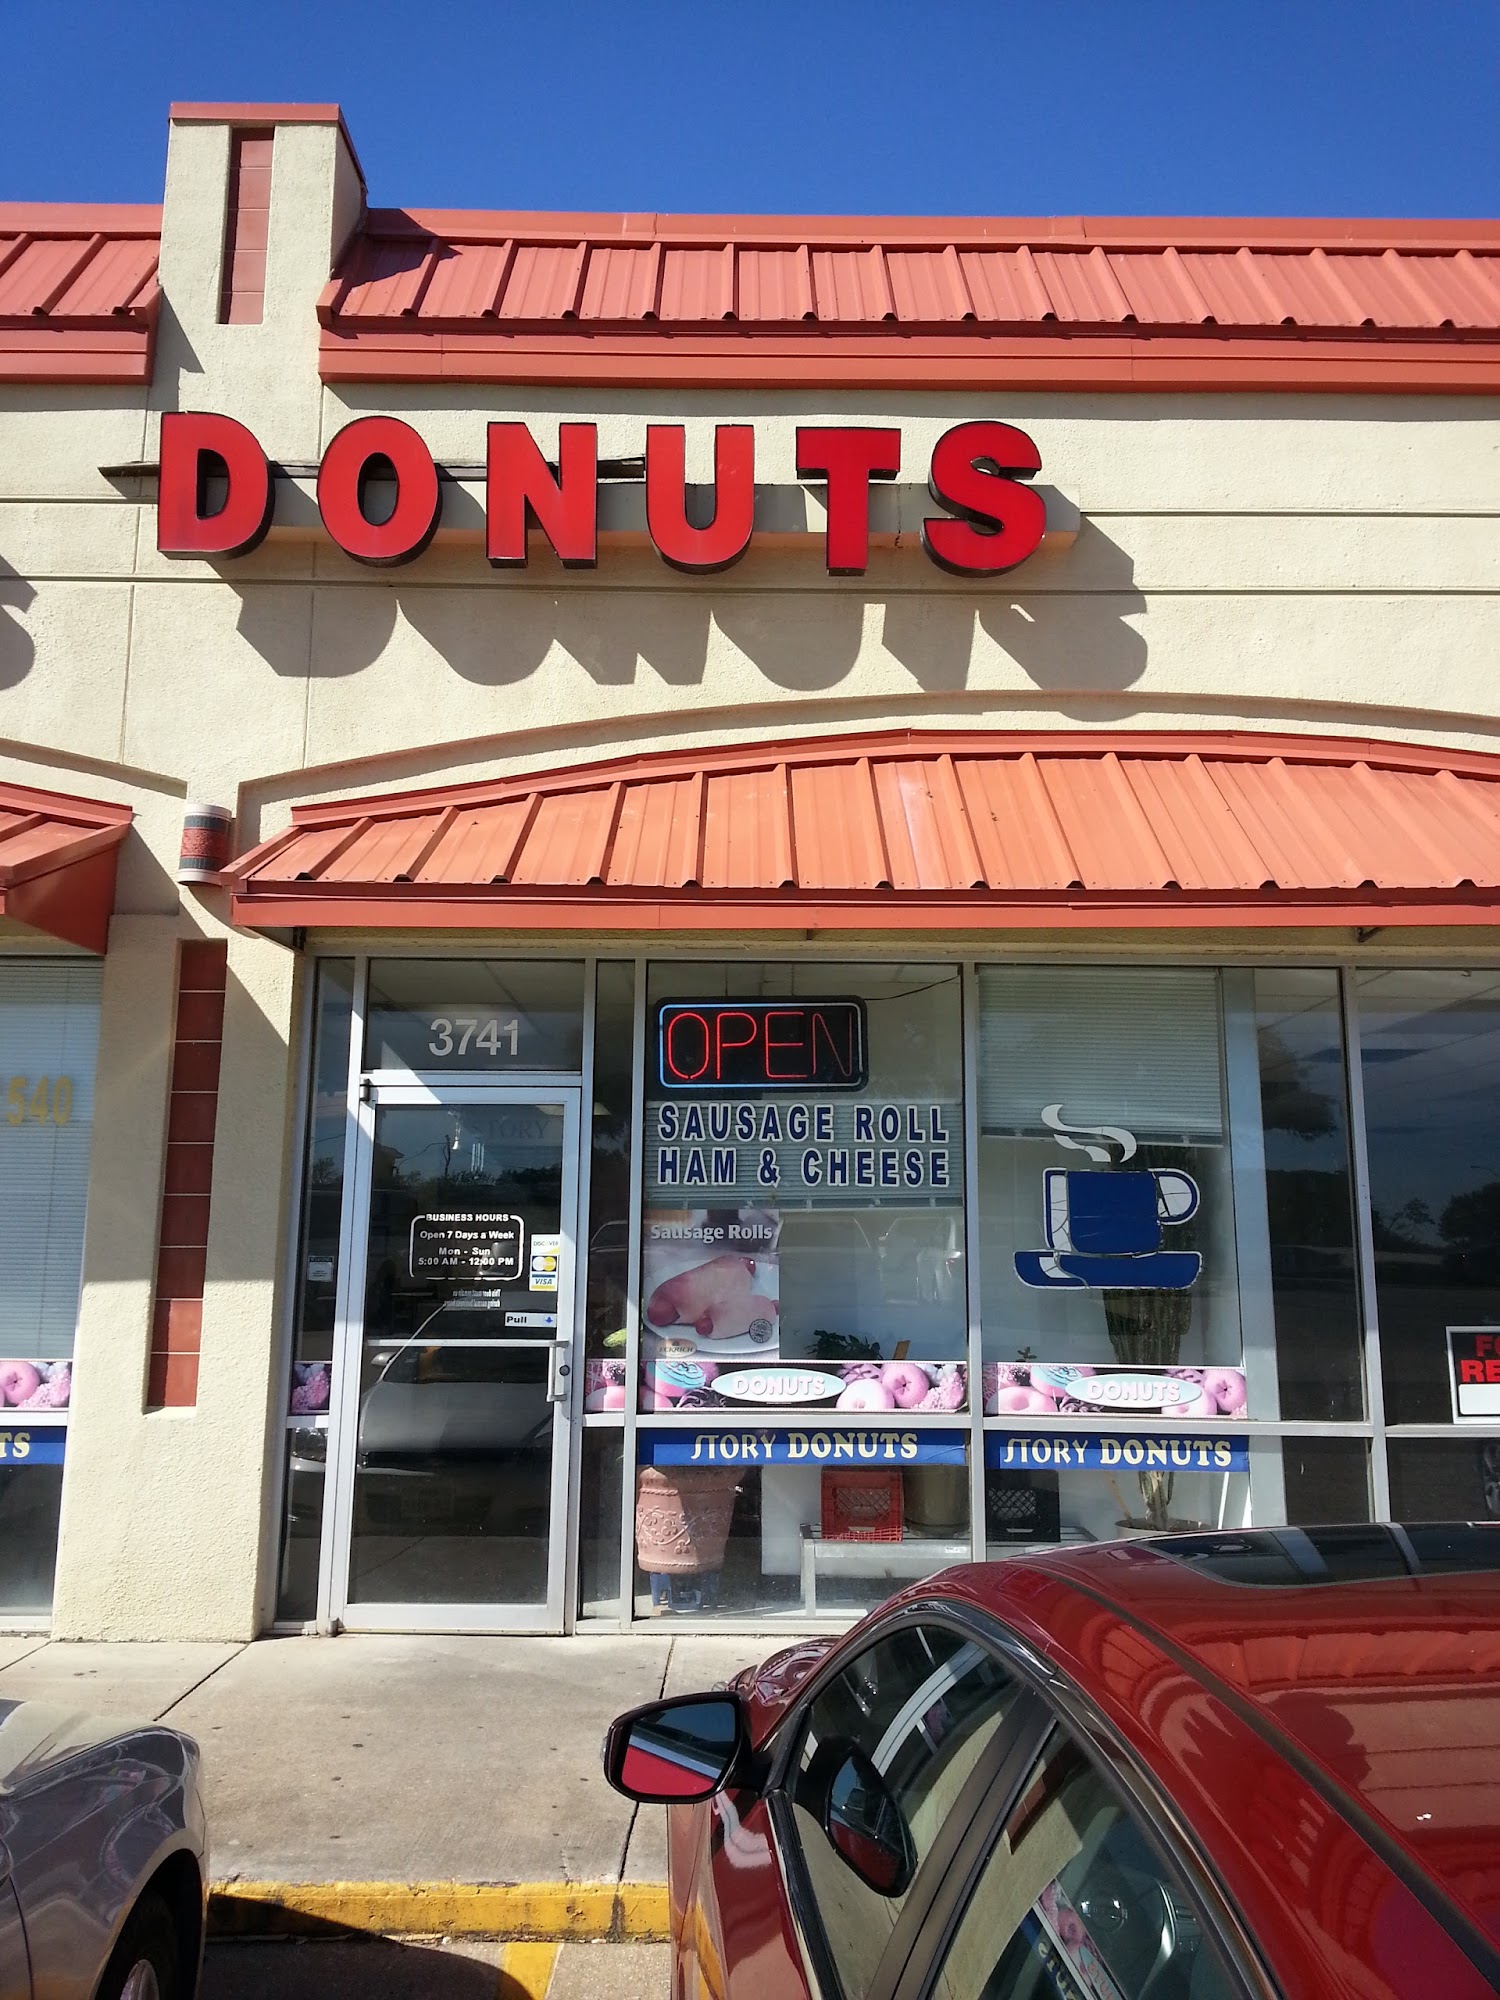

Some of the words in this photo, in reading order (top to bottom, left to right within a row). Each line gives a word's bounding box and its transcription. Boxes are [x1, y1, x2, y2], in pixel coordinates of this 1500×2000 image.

[156, 411, 1047, 575] DONUTS
[429, 1018, 518, 1056] 3741
[668, 1012, 853, 1080] OPEN
[658, 1102, 834, 1142] SAUSAGE
[854, 1105, 949, 1143] ROLL
[658, 1147, 736, 1185] HAM
[757, 1148, 781, 1187] &
[801, 1148, 950, 1187] CHEESE
[426, 1213, 473, 1222] BUSINESS
[475, 1213, 509, 1222] HOURS
[420, 1230, 445, 1240] Open
[447, 1230, 453, 1239] 7
[455, 1230, 479, 1240] Days
[480, 1231, 487, 1239] a
[489, 1230, 515, 1239] Week
[650, 1224, 724, 1244] Sausage
[728, 1224, 773, 1239] Rolls
[418, 1257, 439, 1266] 5:00
[441, 1257, 458, 1266] AM
[468, 1257, 495, 1266] 12:00
[497, 1257, 514, 1266] PM
[438, 1247, 461, 1256] Mon
[472, 1247, 491, 1256] Sun
[506, 1315, 527, 1324] Pull
[1475, 1334, 1500, 1357] F
[733, 1375, 826, 1396] DONUTS
[1086, 1380, 1181, 1402] DONUTS
[690, 1434, 776, 1460] STORY
[787, 1433, 918, 1460] DONUTS
[1003, 1438, 1089, 1464] STORY
[1100, 1439, 1232, 1467] DONUTS
